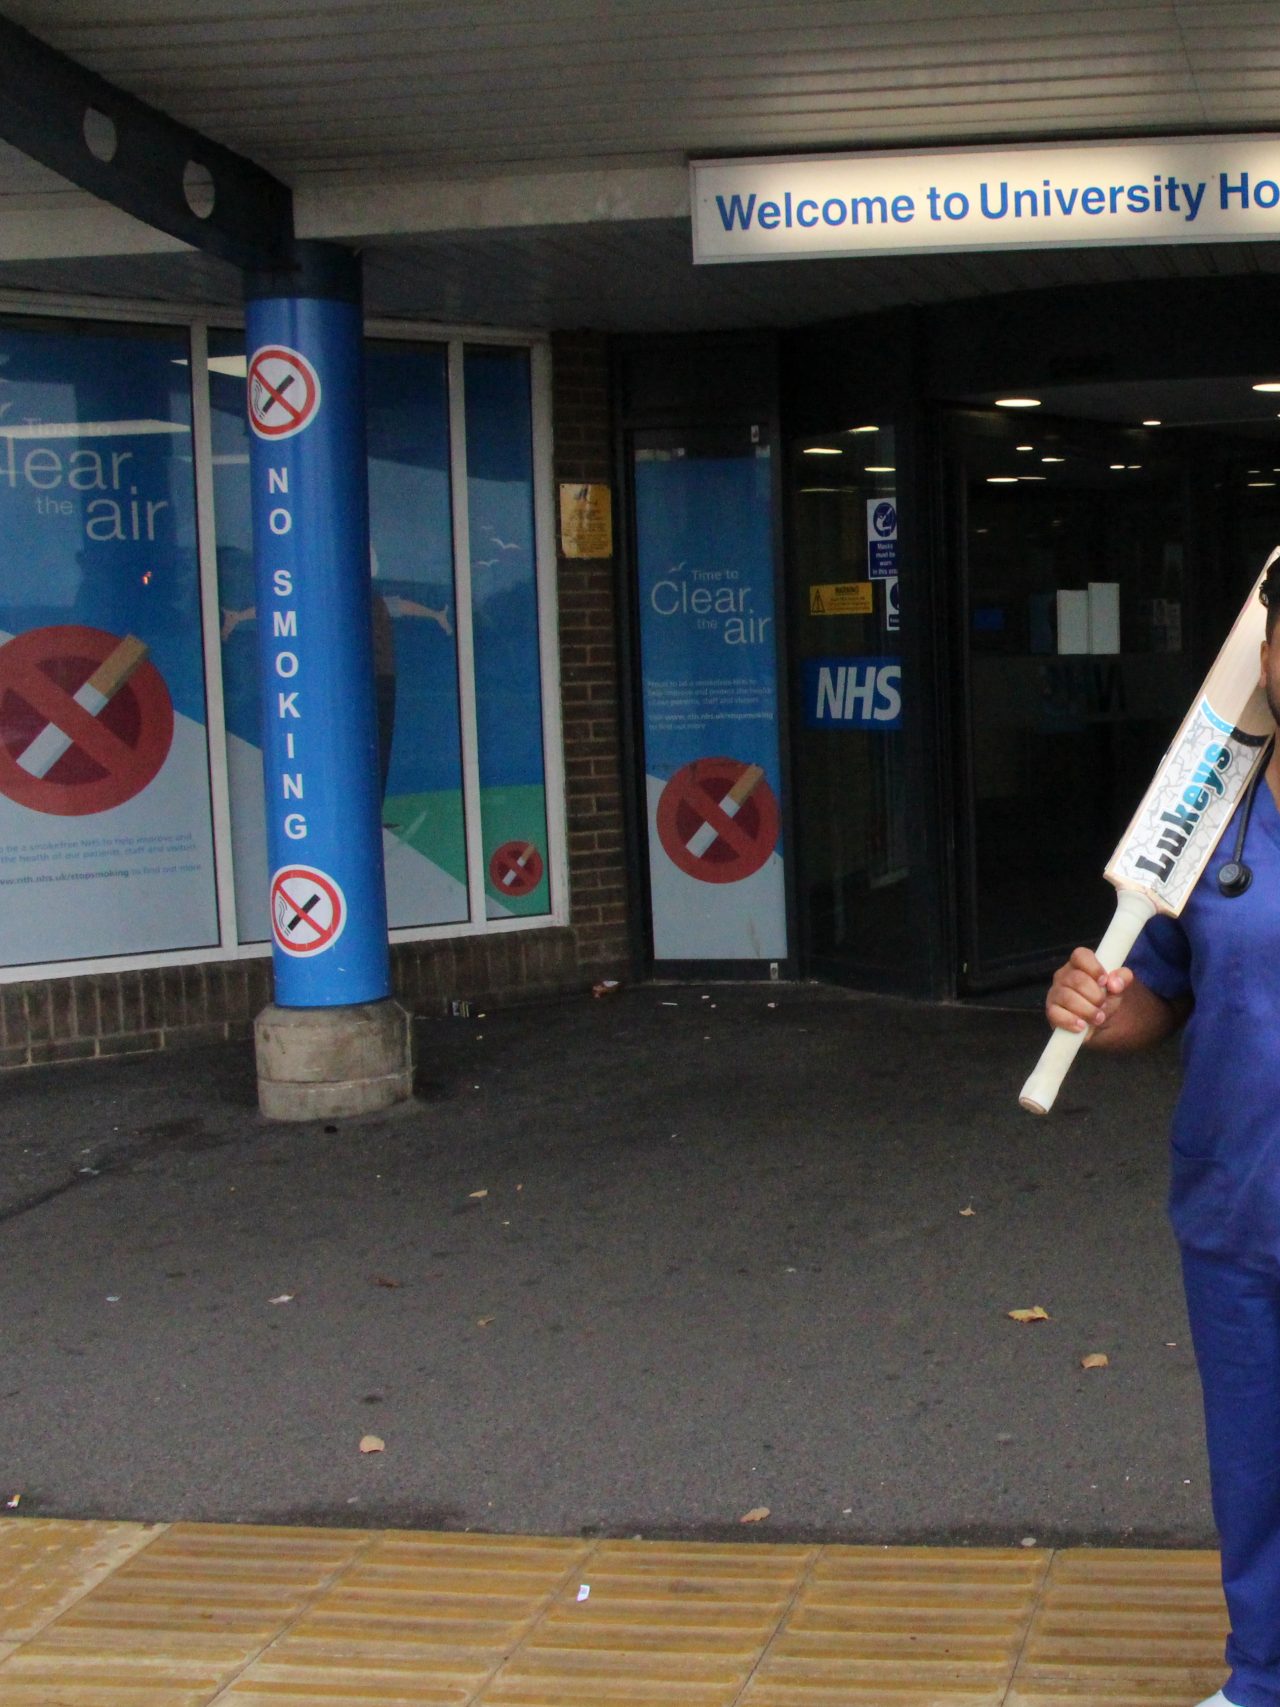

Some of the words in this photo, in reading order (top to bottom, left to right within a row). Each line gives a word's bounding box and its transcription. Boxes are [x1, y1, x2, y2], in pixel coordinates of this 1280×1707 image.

[716, 192, 915, 231] Welcome
[927, 186, 969, 221] to
[980, 175, 1206, 222] University
[7, 432, 133, 490] lear
[38, 496, 73, 515] the
[86, 486, 168, 541] air
[268, 467, 292, 535] NO
[651, 580, 753, 615] Clear
[692, 570, 722, 581] Time
[727, 569, 739, 580] to
[697, 618, 719, 630] the
[724, 608, 772, 645] air
[273, 569, 307, 840] SMOKING
[816, 665, 901, 720] NHS
[1136, 743, 1232, 883] Lukeys
